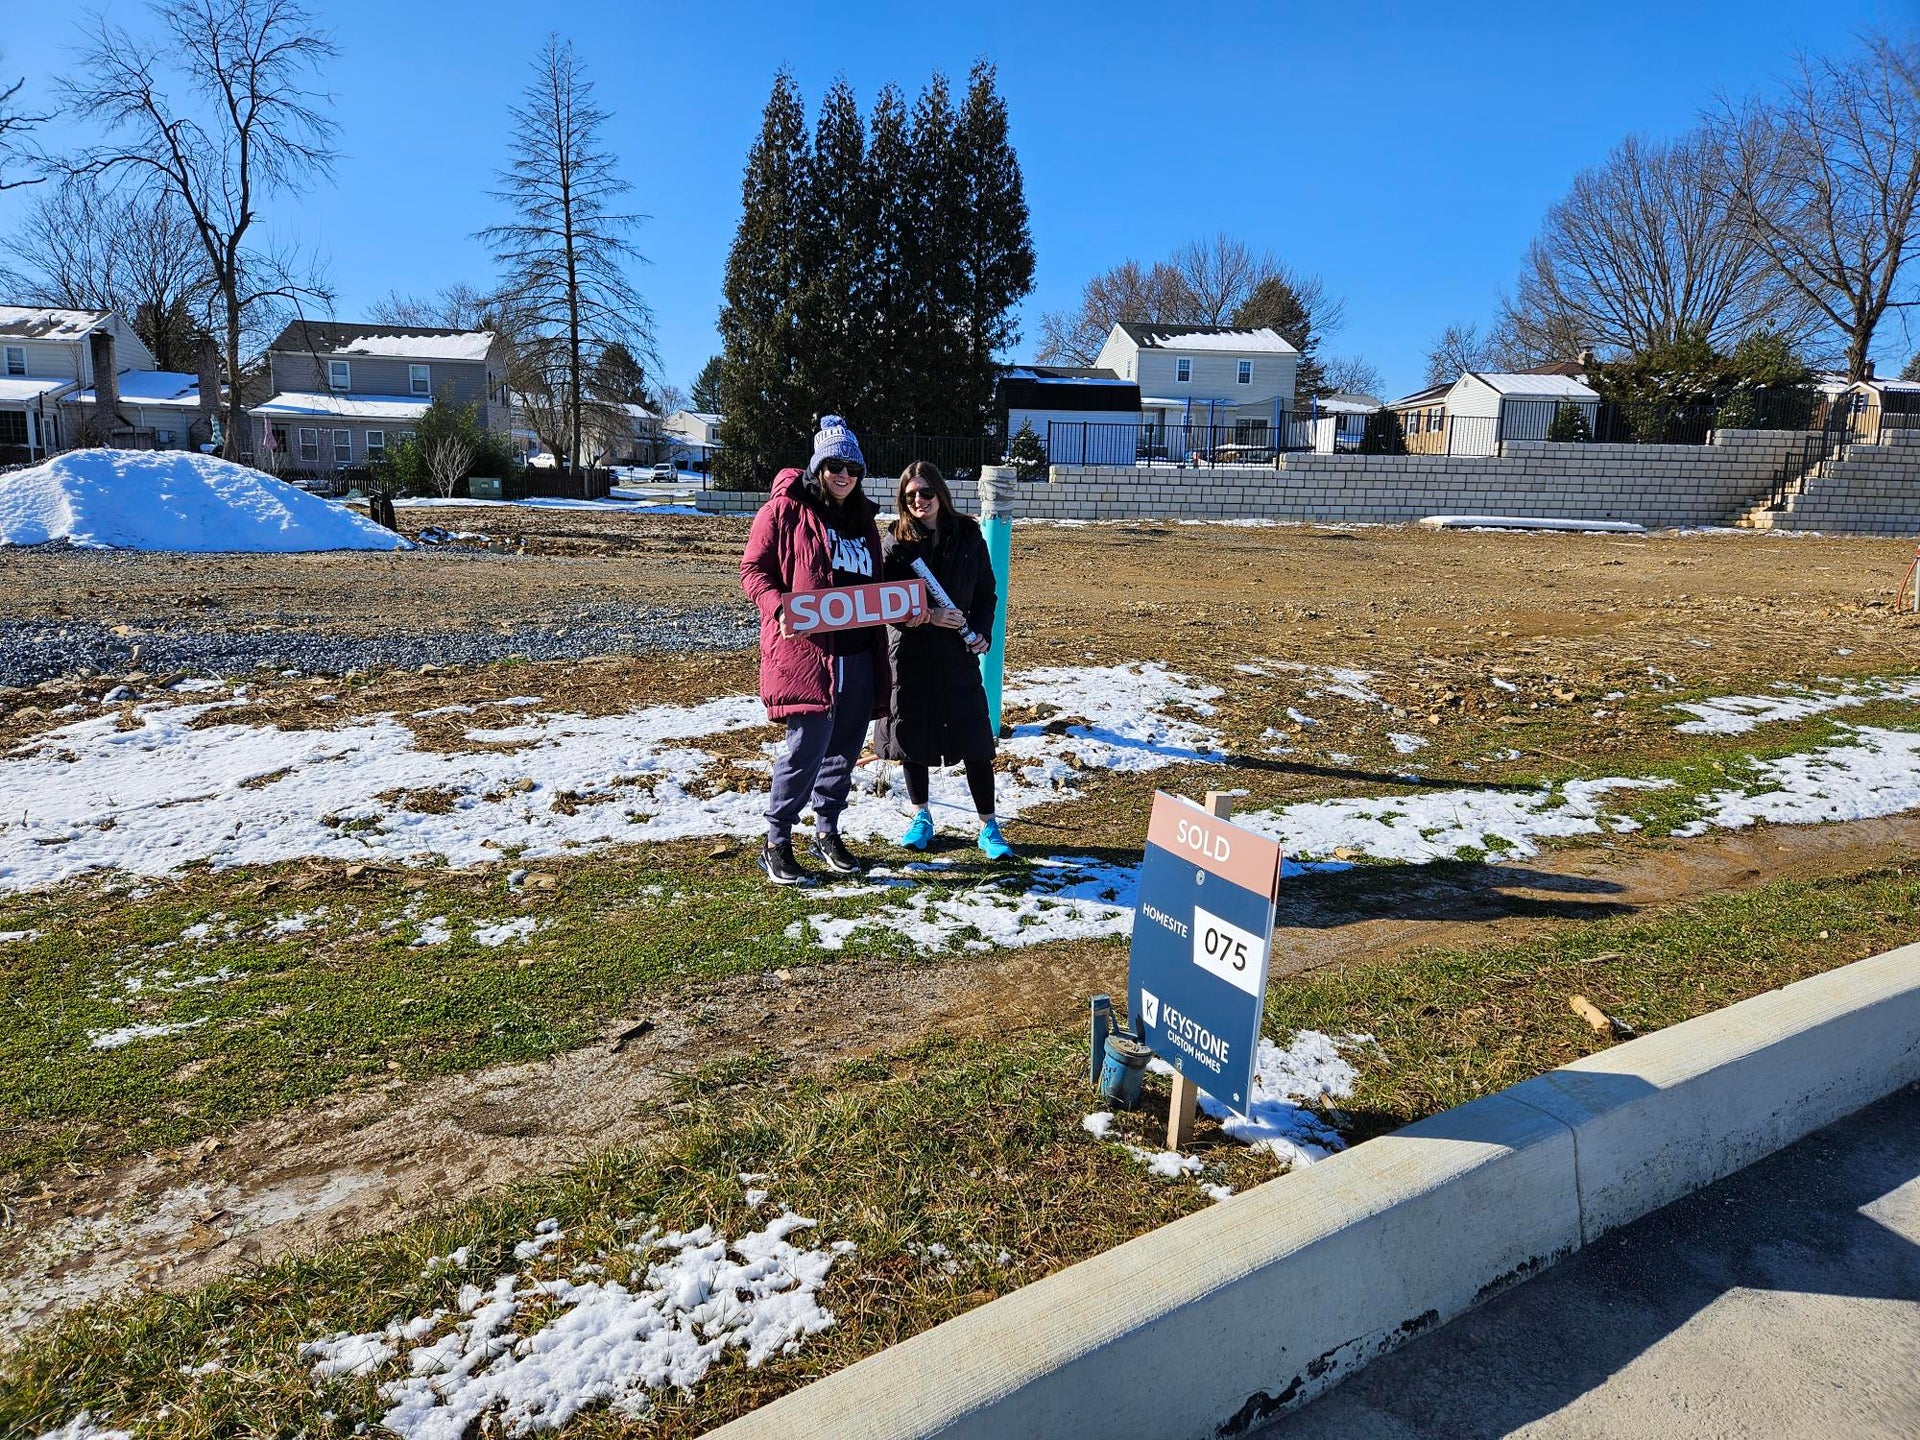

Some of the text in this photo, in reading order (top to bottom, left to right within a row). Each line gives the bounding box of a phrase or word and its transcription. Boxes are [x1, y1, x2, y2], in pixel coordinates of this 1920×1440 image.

[790, 584, 922, 631] SOLD!
[1176, 819, 1231, 862] SOLD
[1142, 902, 1189, 939] HOMESITE
[1204, 927, 1248, 972] 075
[1162, 1003, 1230, 1065] KEYSTONE
[1167, 1029, 1221, 1075] CUSTOM HOMES
